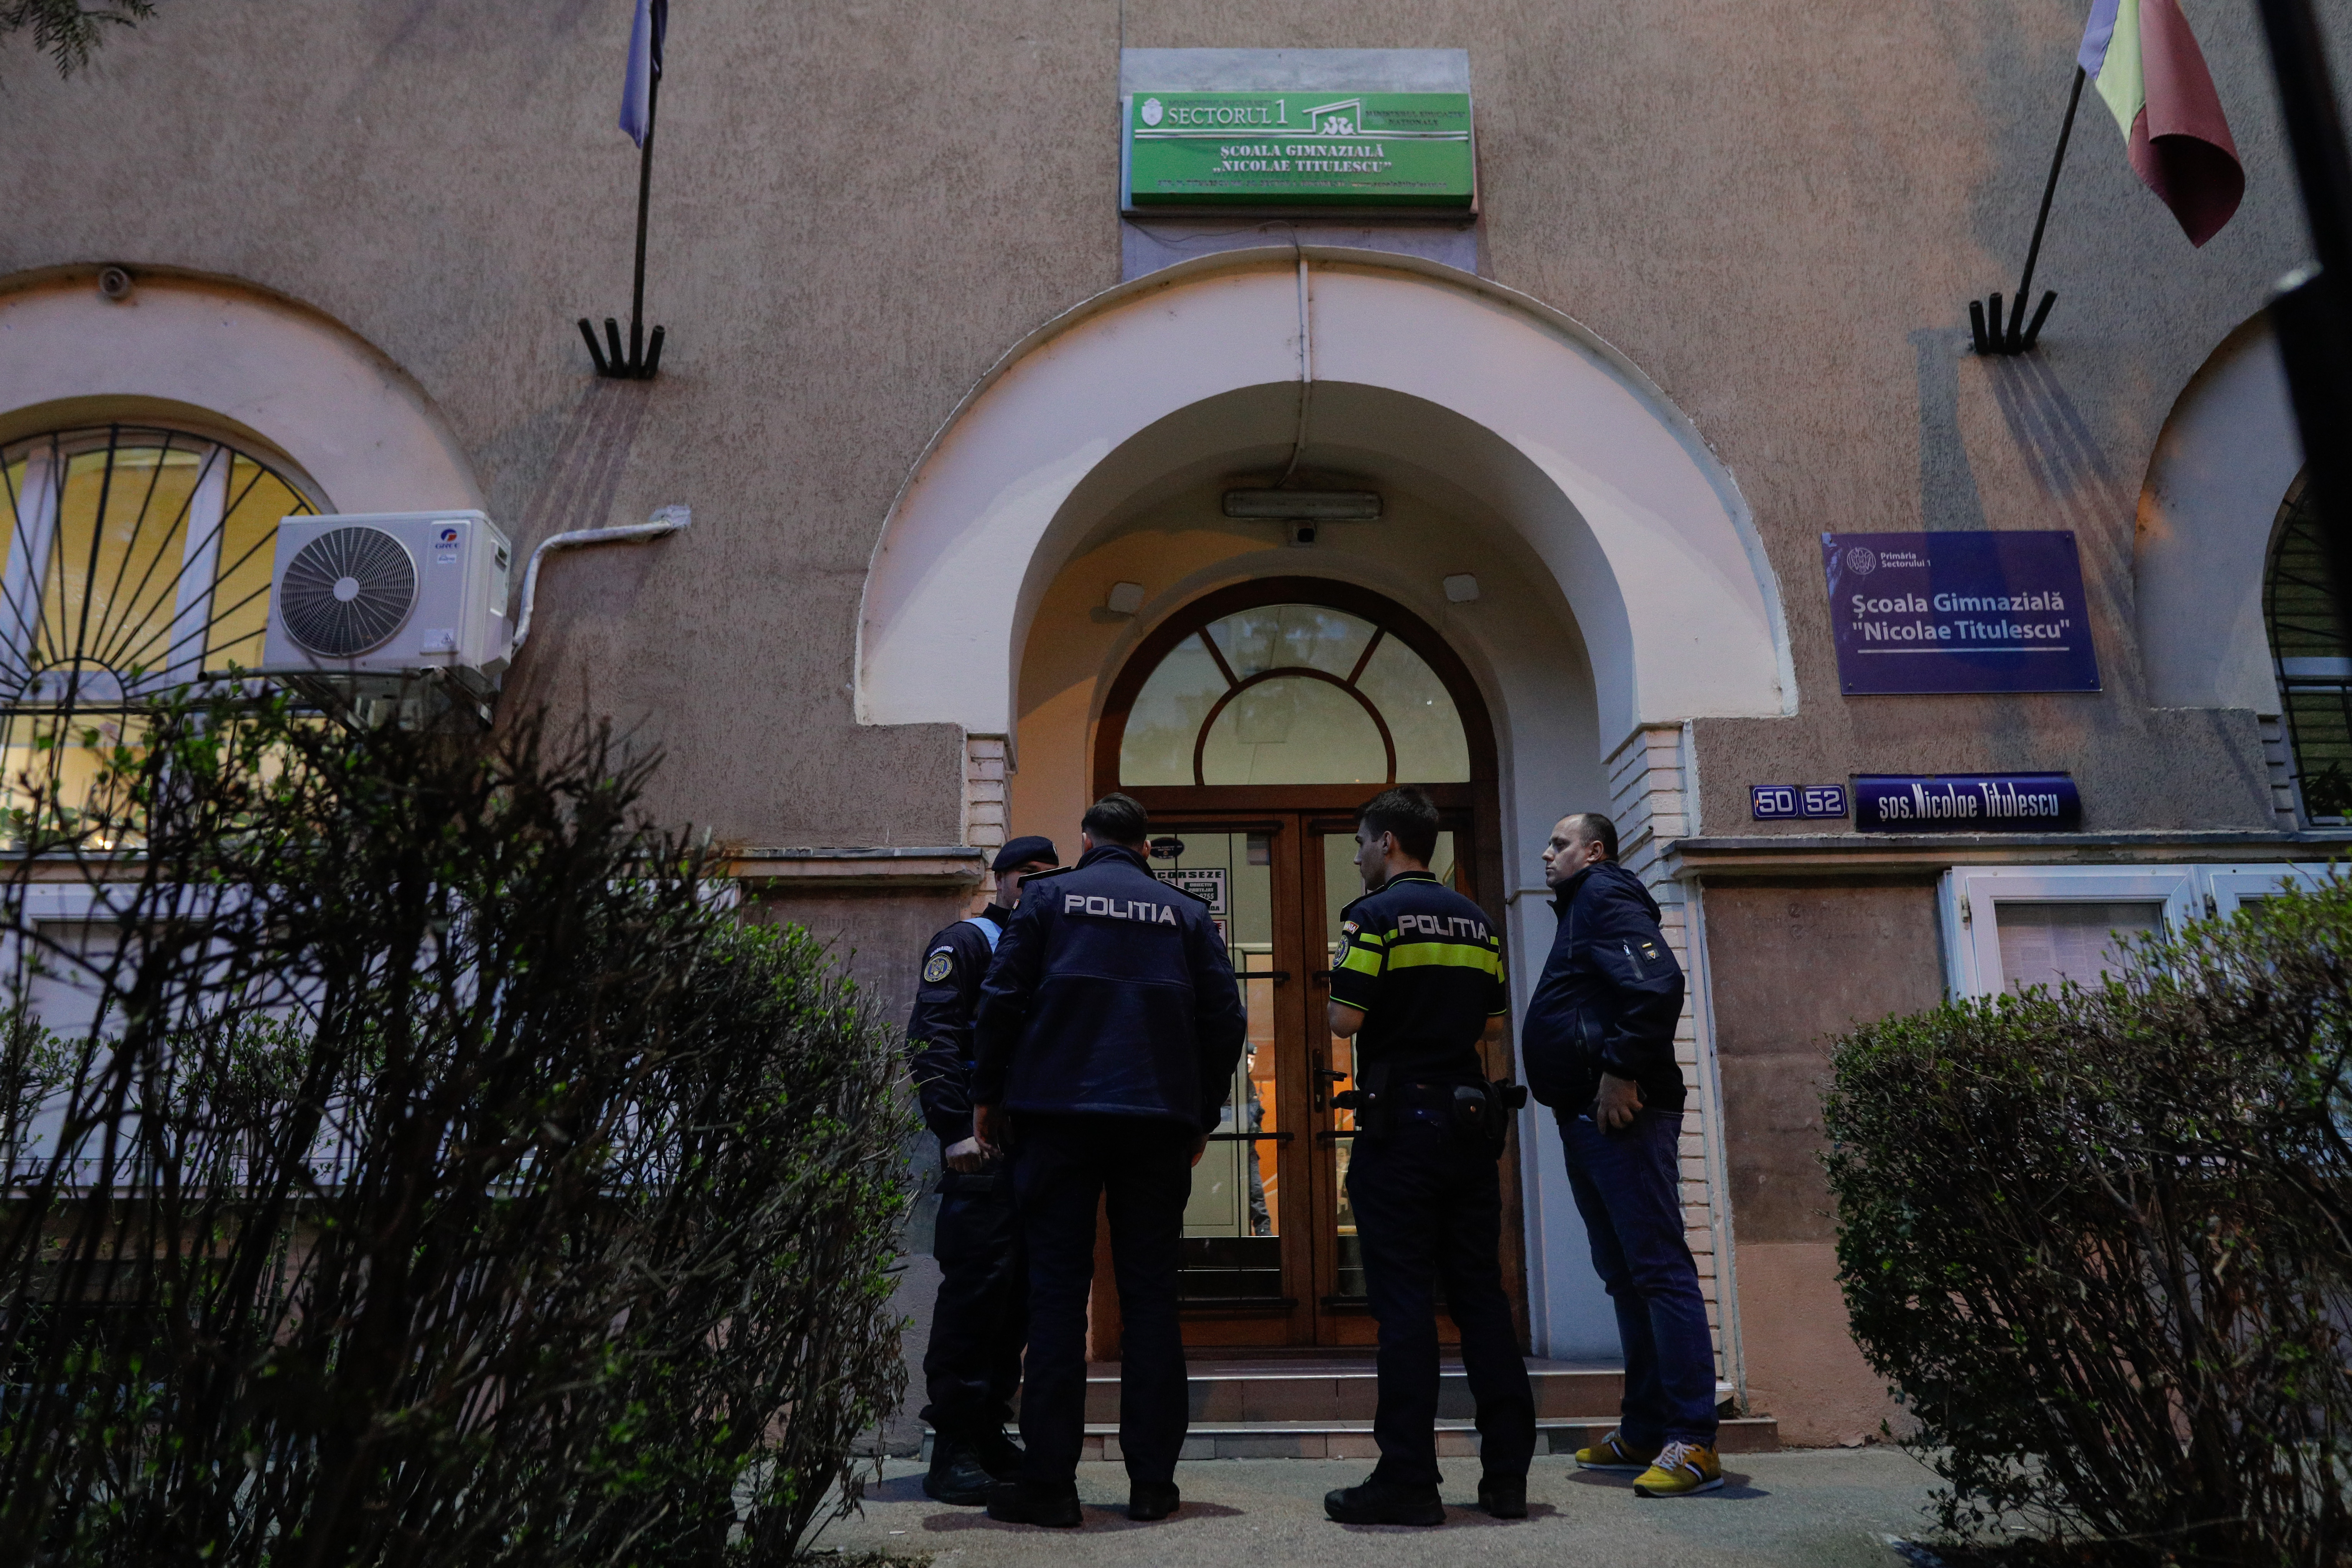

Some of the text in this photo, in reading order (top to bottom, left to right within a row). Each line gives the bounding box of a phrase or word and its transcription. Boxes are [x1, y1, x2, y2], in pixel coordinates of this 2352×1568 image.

[1168, 99, 1288, 125] SECTORUL 1
[1220, 144, 1384, 160] ȘCOALA GIMNAZIALĂ
[1212, 160, 1392, 173] „NICOLAE TITULESCU”
[1881, 559, 1925, 568] Sectorului
[1851, 591, 2064, 619] Școala Gimnazială
[1852, 619, 2070, 641] "Nicolae Titulescu"
[1757, 791, 1793, 813] 50
[1805, 791, 1841, 812] 52
[1912, 783, 1977, 819] Nicolae
[1978, 782, 2059, 817] Titulescu
[1064, 894, 1176, 926] POLITIA
[1397, 915, 1489, 943] POLITIA
